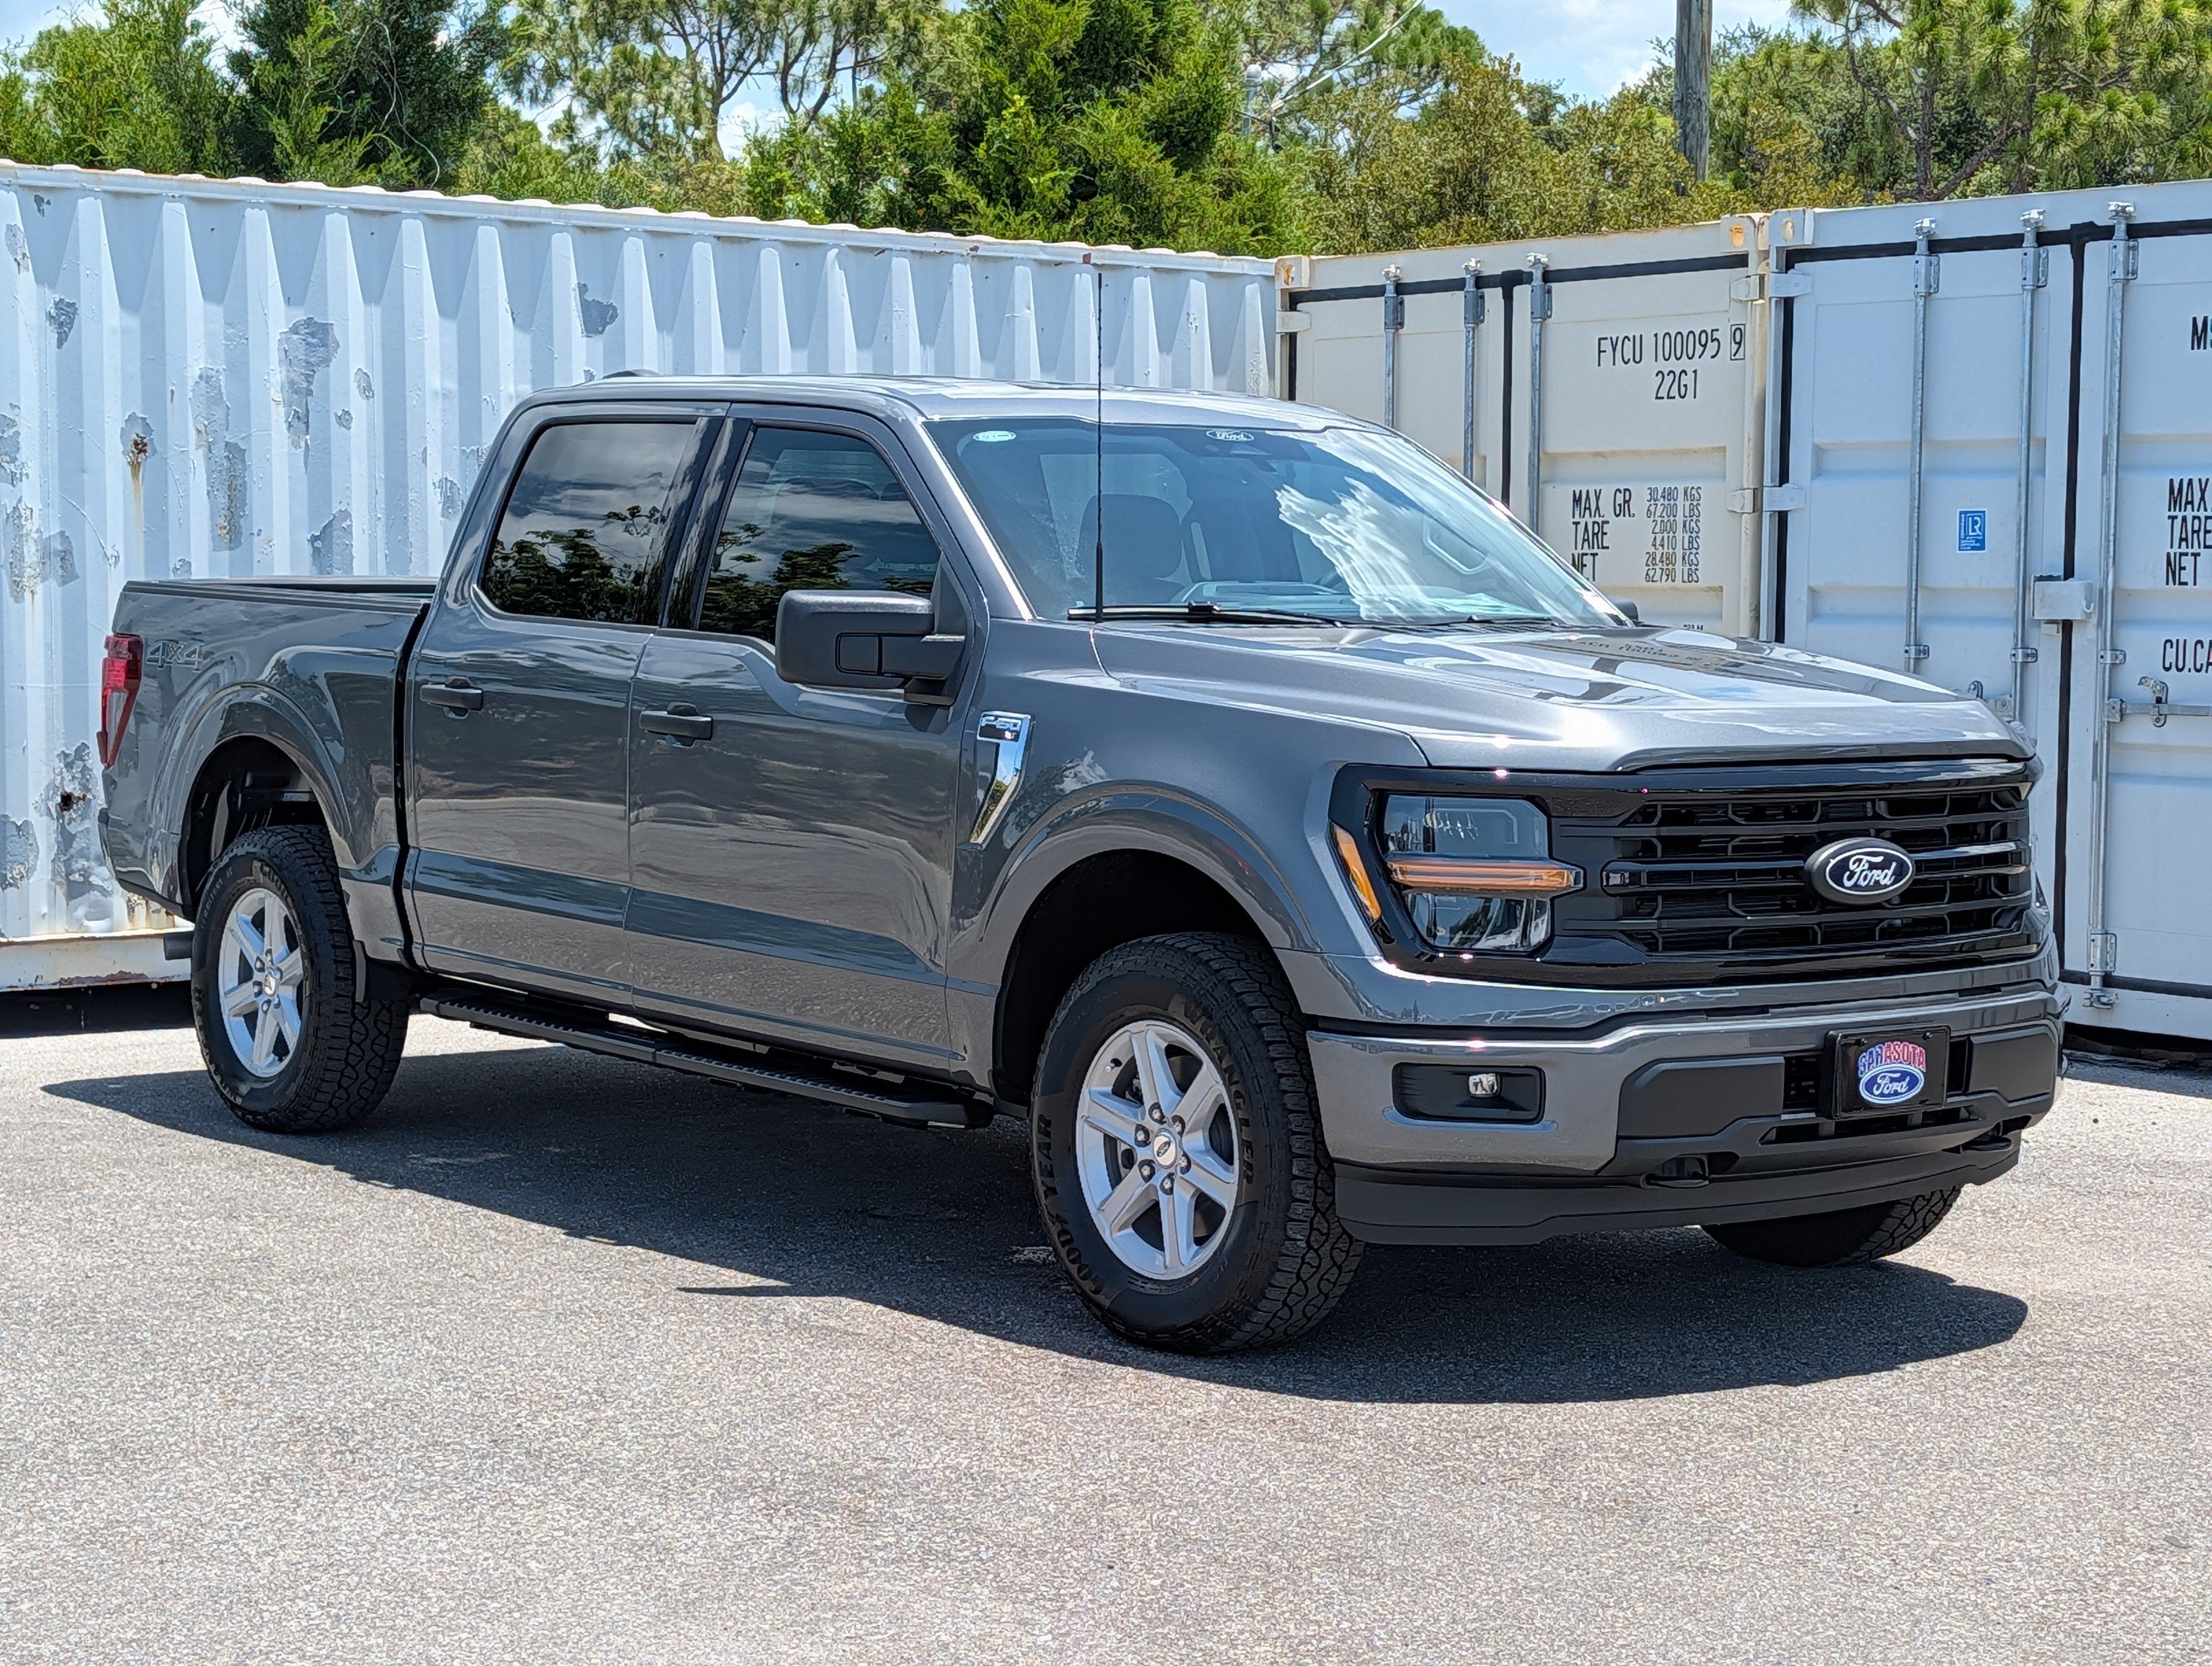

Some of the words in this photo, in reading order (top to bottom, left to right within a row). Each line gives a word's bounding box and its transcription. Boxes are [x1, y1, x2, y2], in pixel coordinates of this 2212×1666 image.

[1597, 334, 1643, 367] FYCU
[1653, 328, 1721, 363] 100095
[1732, 326, 1744, 358] 9
[2190, 315, 2212, 350] M
[1654, 368, 1697, 400] 22G1
[1572, 488, 1605, 519] MAX.
[1613, 488, 1636, 518] GR.
[1683, 486, 1702, 502] KGS
[1682, 502, 1701, 518] LBS
[1572, 520, 1610, 550] TARE
[1682, 518, 1701, 534] KGS
[2167, 515, 2212, 549] TARE
[1681, 535, 1700, 551] LBS
[1681, 551, 1700, 567] KGS
[2165, 552, 2201, 586] NET
[1681, 567, 1700, 584] LBS
[1843, 855, 1897, 887] Ford
[1873, 1072, 1911, 1095] Ford
